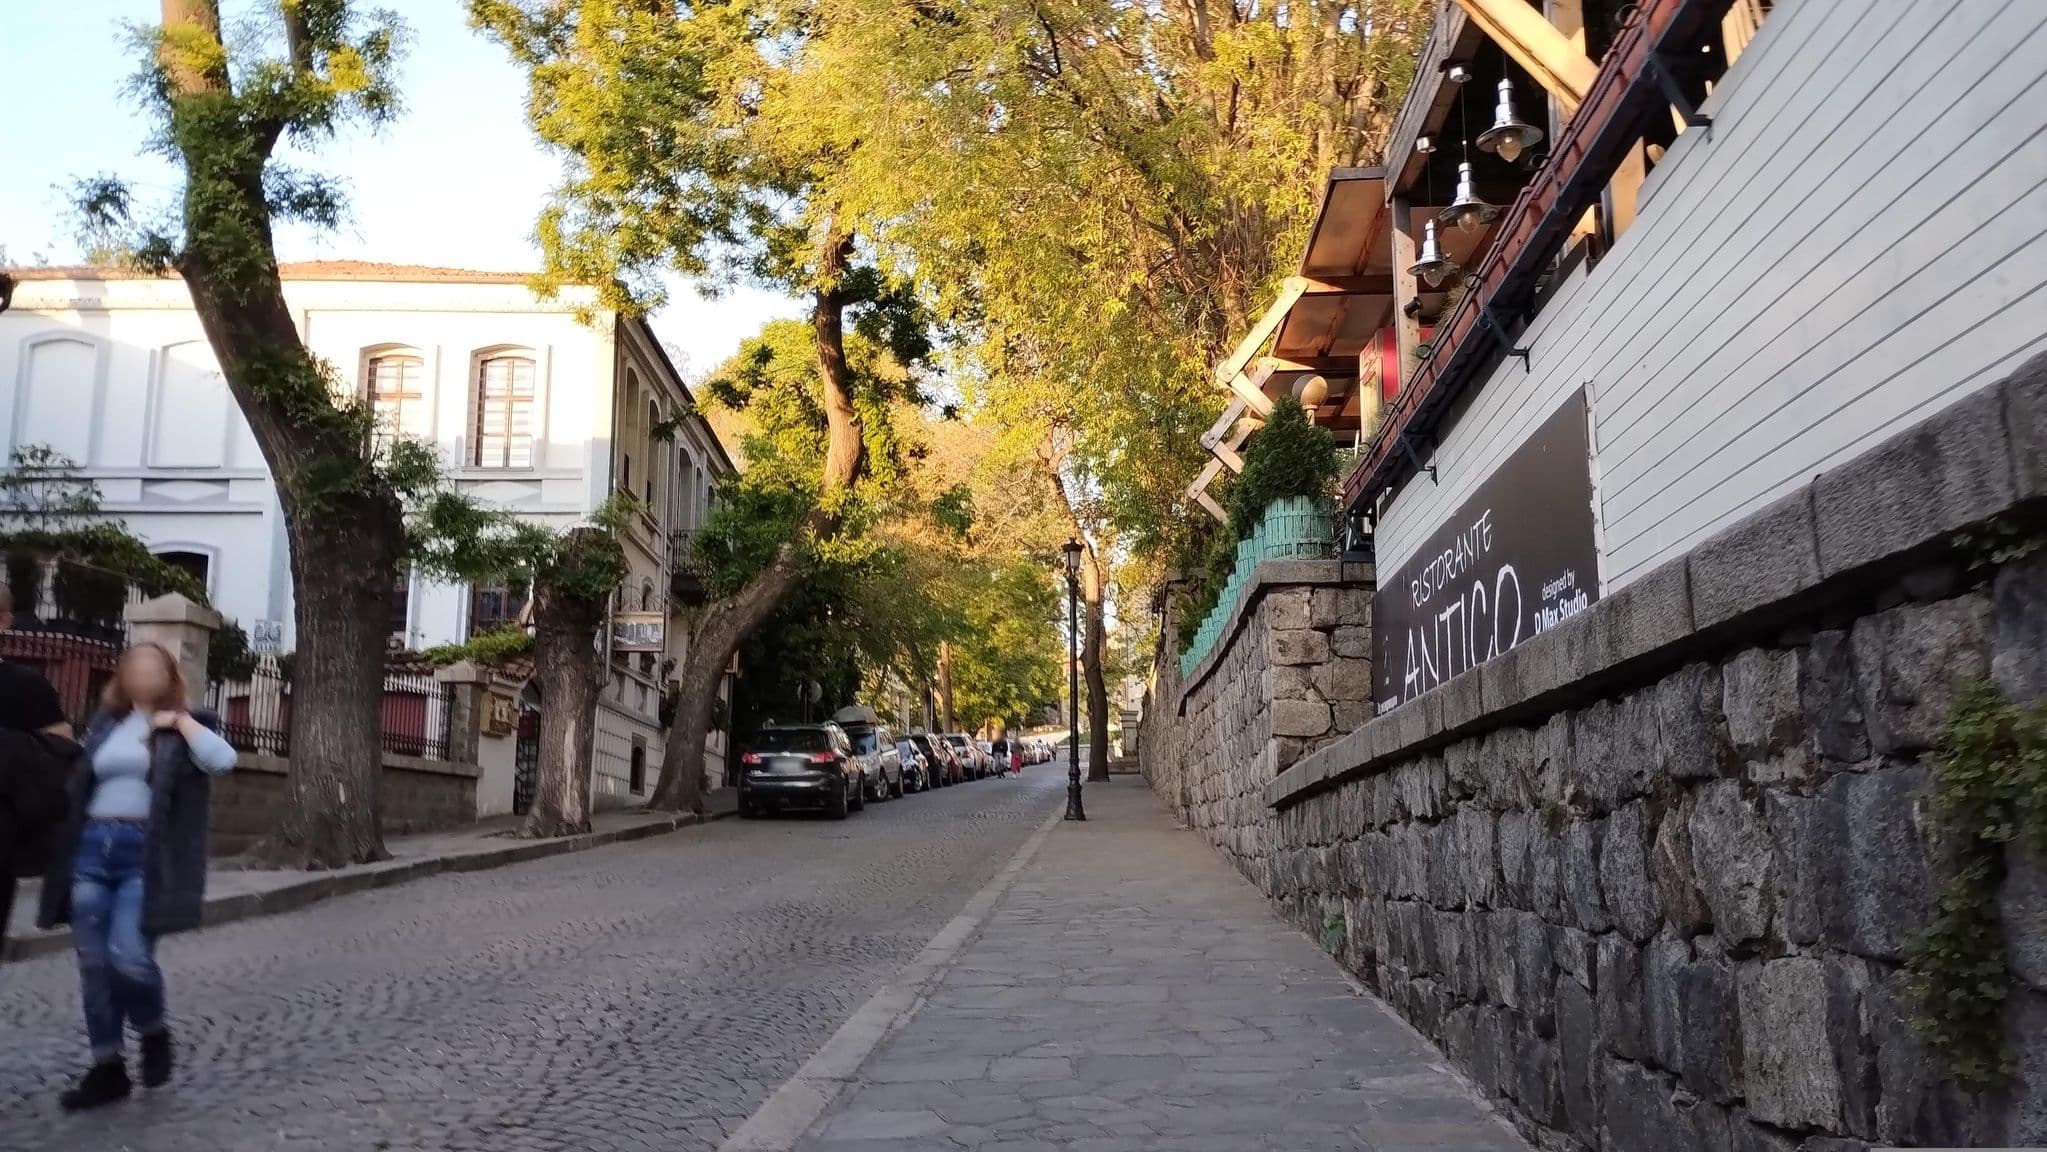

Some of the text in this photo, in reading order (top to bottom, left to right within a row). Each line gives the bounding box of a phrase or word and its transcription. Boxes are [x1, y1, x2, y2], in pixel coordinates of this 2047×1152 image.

[1411, 509, 1492, 611] RISTORANTE
[1541, 568, 1576, 601] designed by
[1403, 564, 1522, 704] ANTICO
[1541, 606, 1559, 632] Max
[1559, 587, 1588, 621] Studio
